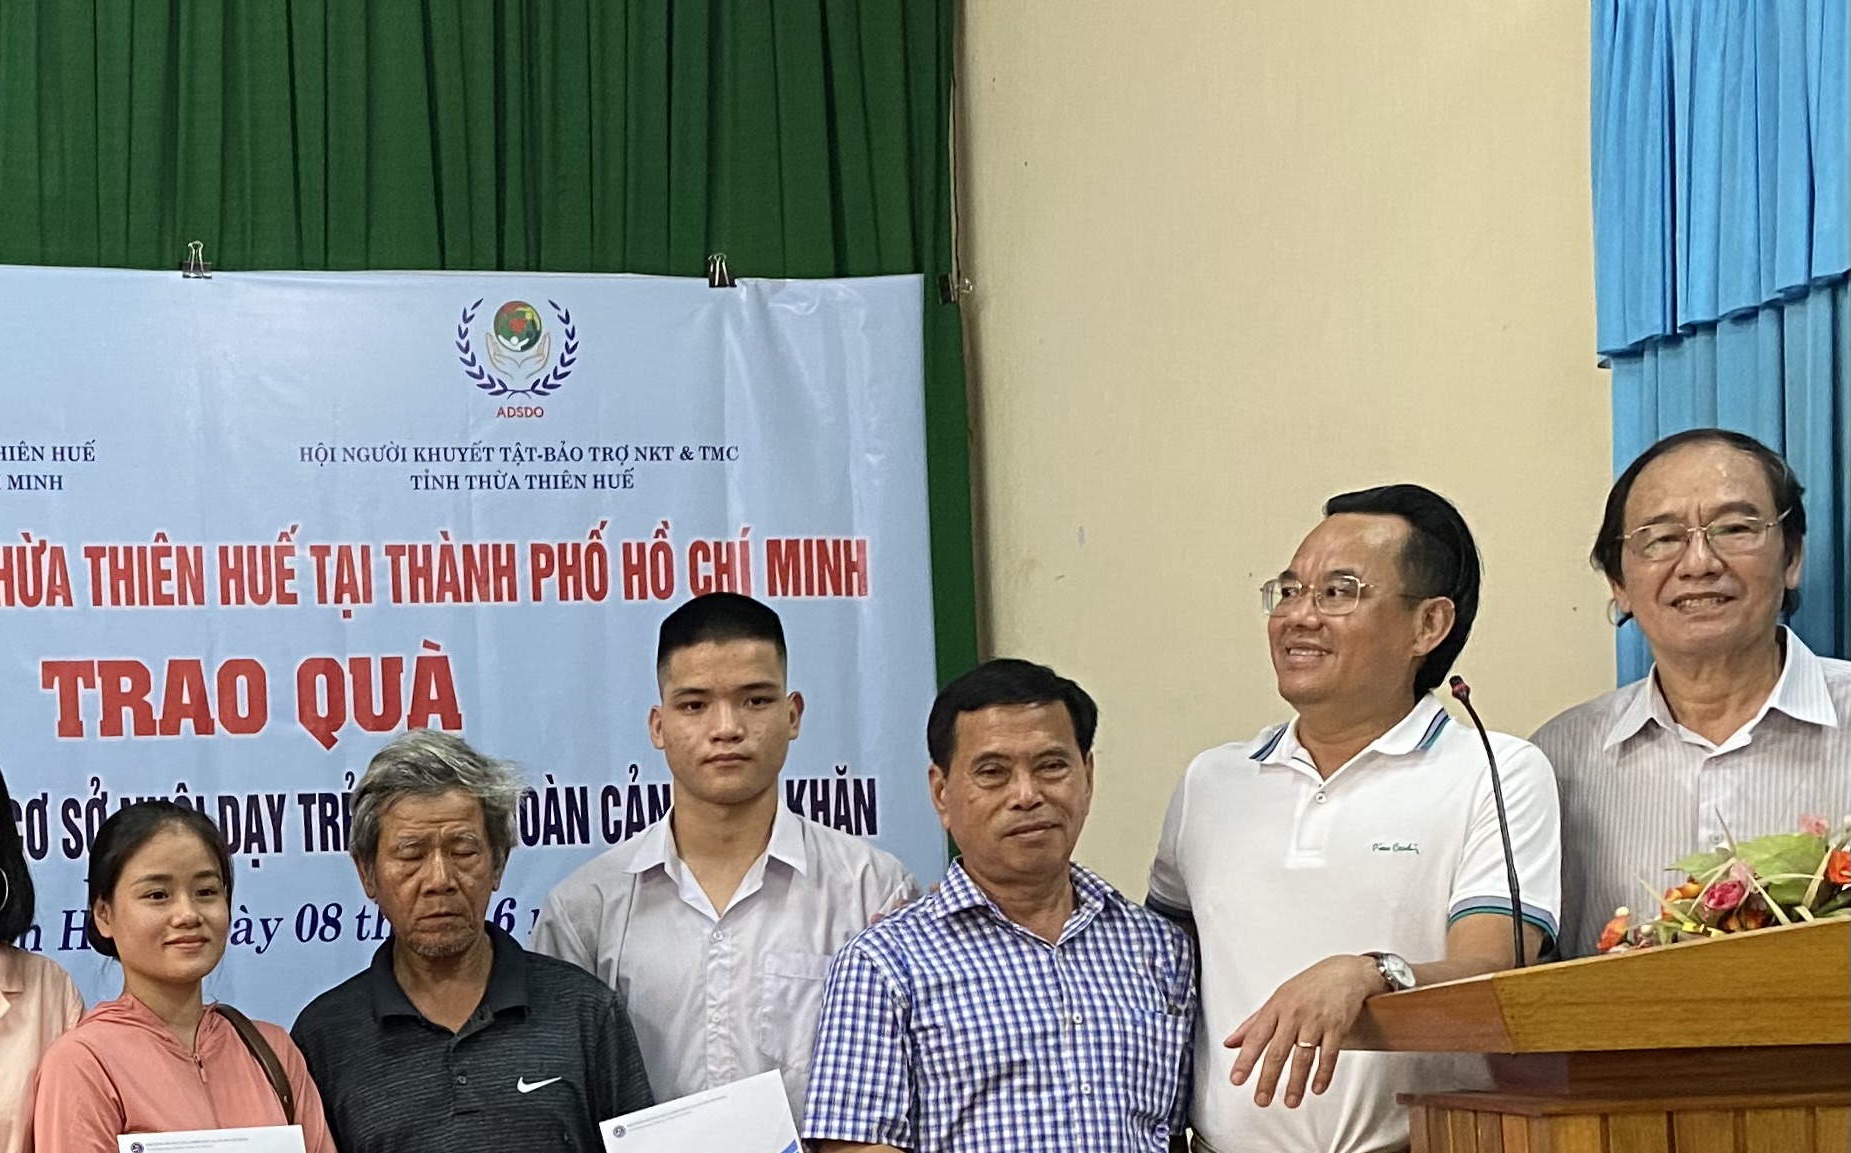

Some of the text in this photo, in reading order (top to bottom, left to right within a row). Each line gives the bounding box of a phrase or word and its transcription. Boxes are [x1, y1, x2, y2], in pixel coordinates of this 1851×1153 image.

[496, 406, 544, 418] ADSDO
[51, 439, 96, 463] HUẾ
[299, 440, 740, 468] HỘI NGƯỜI KHUYẾT TẬT-BẢO TRỢ NKT & TMC
[7, 474, 64, 491] MINH
[410, 466, 635, 491] TỈNH THỪA THIÊN HUẾ
[84, 531, 205, 607] THIÊN
[218, 524, 299, 606] HUẾ
[309, 545, 373, 619] TẠI
[385, 530, 518, 604] THÀNH
[530, 520, 608, 602] PHỐ
[622, 520, 674, 601] HỒ
[688, 526, 752, 598] CHÍ
[766, 538, 869, 597] MINH
[41, 639, 463, 751] TRAO QUÀ
[217, 793, 287, 868] DẠY
[519, 774, 589, 847] OÀN
[600, 763, 670, 842] CẢN
[785, 765, 878, 836] KHĂN
[295, 902, 344, 943] 08
